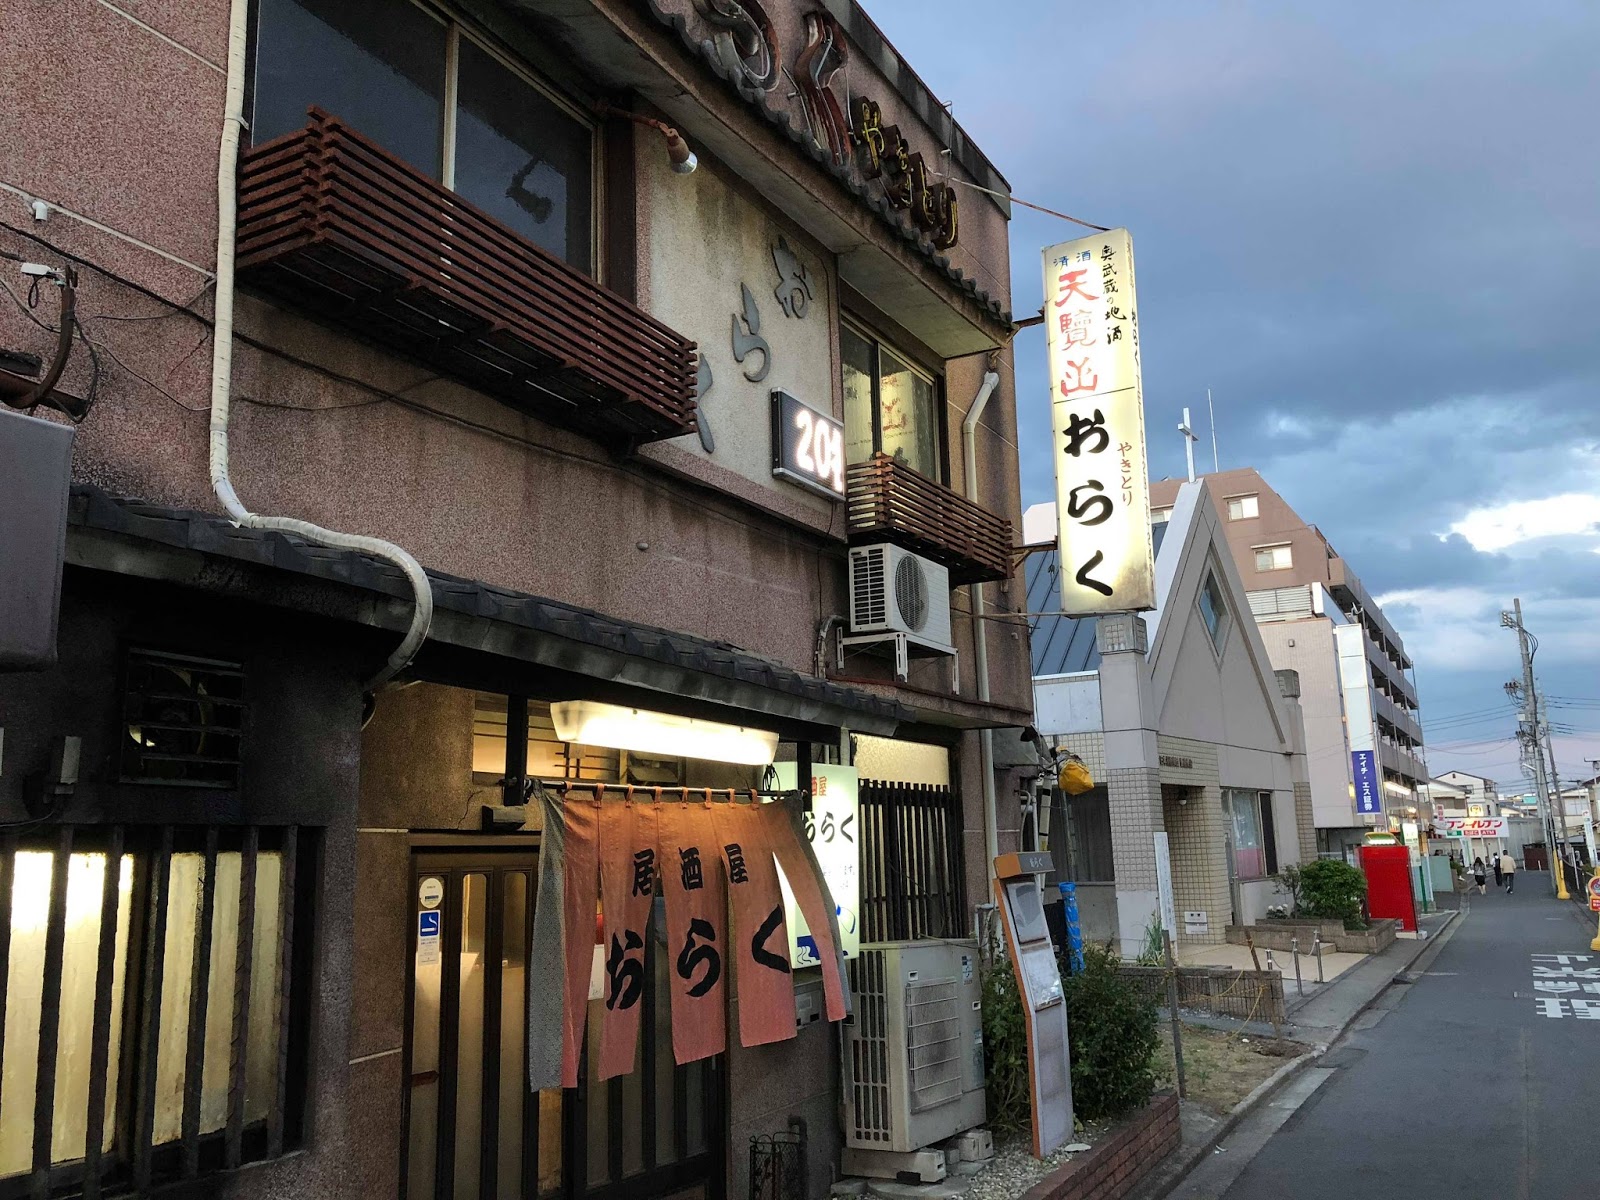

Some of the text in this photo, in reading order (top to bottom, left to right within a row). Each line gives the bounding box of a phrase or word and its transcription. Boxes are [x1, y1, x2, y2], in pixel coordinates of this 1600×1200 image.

[1053, 250, 1091, 268] 清酒
[1062, 408, 1114, 596] おらく
[1116, 442, 1132, 506] やきとり
[632, 843, 749, 897] 居酒屋
[606, 904, 791, 1010] おらく
